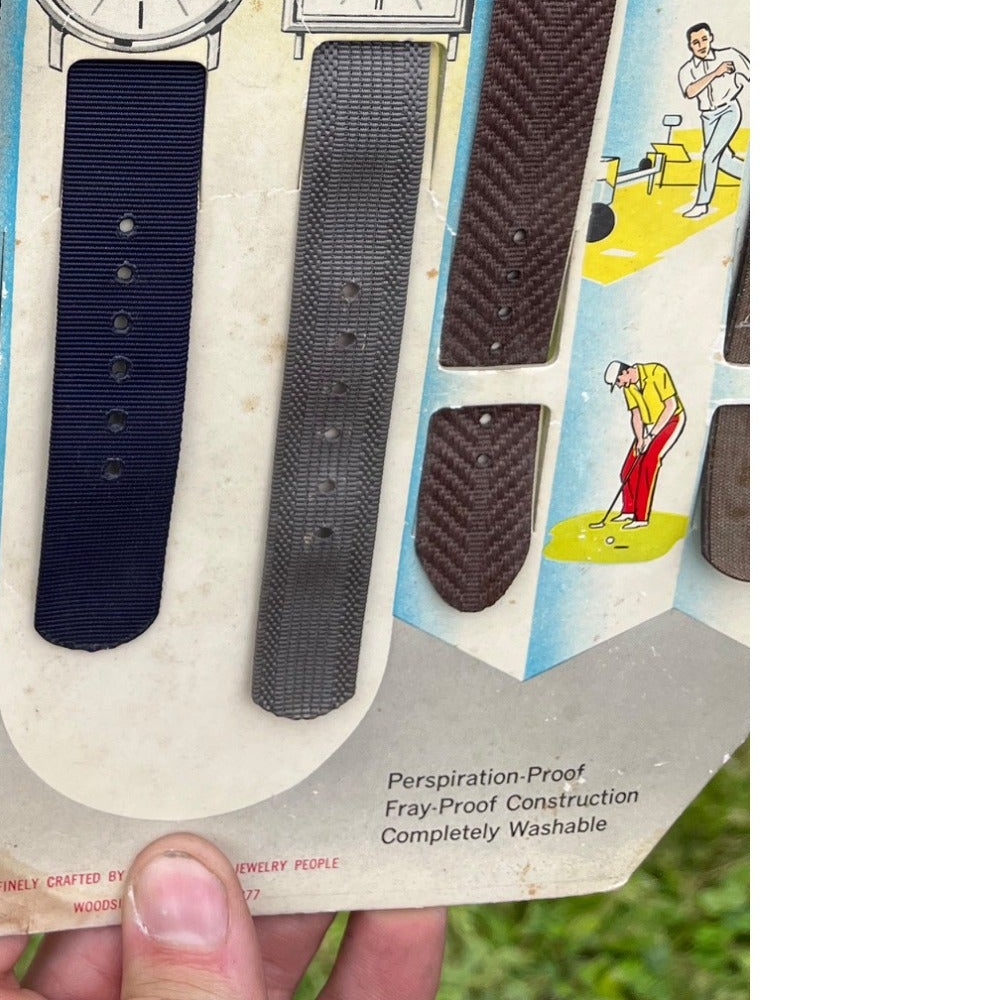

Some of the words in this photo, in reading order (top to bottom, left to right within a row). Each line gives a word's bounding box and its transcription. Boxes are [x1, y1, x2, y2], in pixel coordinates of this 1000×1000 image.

[387, 763, 586, 791] Perspiration-Proof
[385, 795, 498, 820] Fray-Proof
[506, 789, 639, 812] Construction
[380, 822, 501, 846] Completely
[509, 815, 608, 838] Washable
[46, 872, 101, 888] CRAFTED
[108, 870, 125, 882] BY
[235, 860, 288, 874] JEWELRY
[294, 857, 340, 871] PEOPLE
[242, 889, 260, 901] 77
